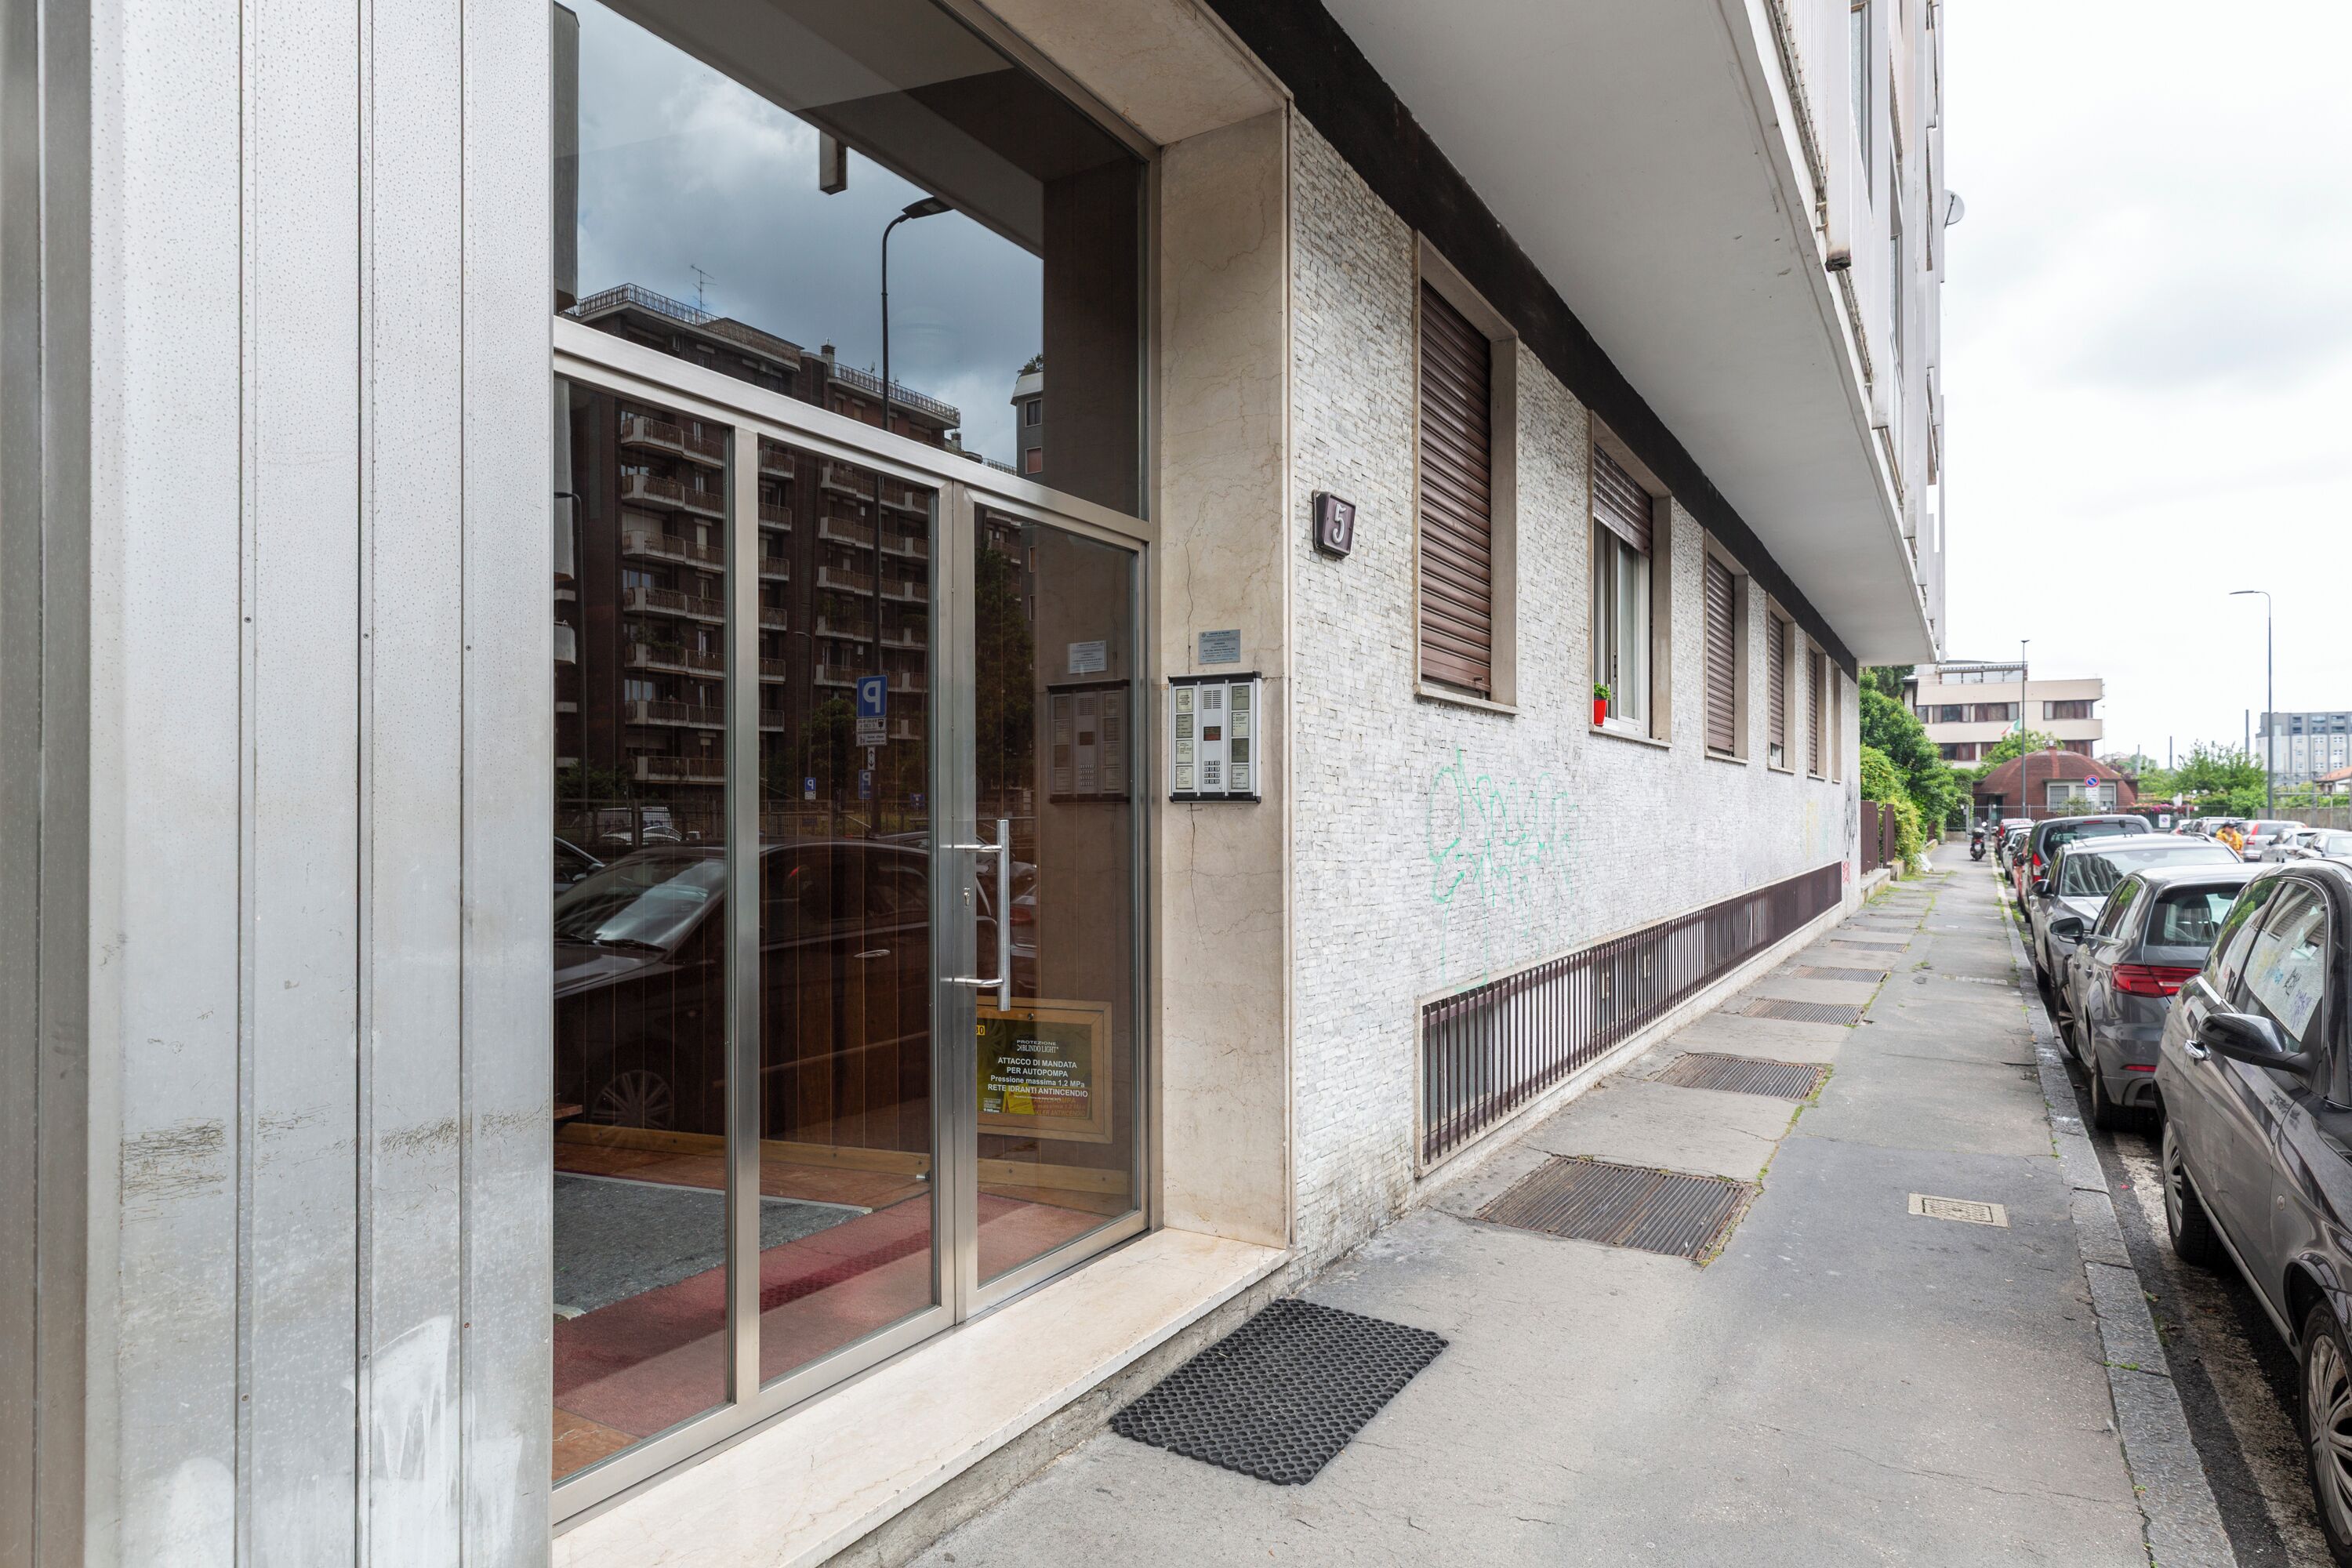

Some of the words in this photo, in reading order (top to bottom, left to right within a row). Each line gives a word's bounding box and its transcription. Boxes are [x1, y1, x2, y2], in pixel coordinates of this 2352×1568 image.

[1333, 503, 1346, 543] 5
[998, 1057, 1031, 1065] ATTACCO
[1042, 1060, 1077, 1069] MANDATA
[1022, 1068, 1068, 1077] AUTOPOMPA
[991, 1075, 1024, 1083] Pressione
[1008, 1085, 1036, 1094] IDRANTI
[1038, 1087, 1088, 1097] ANTINCENDIO
